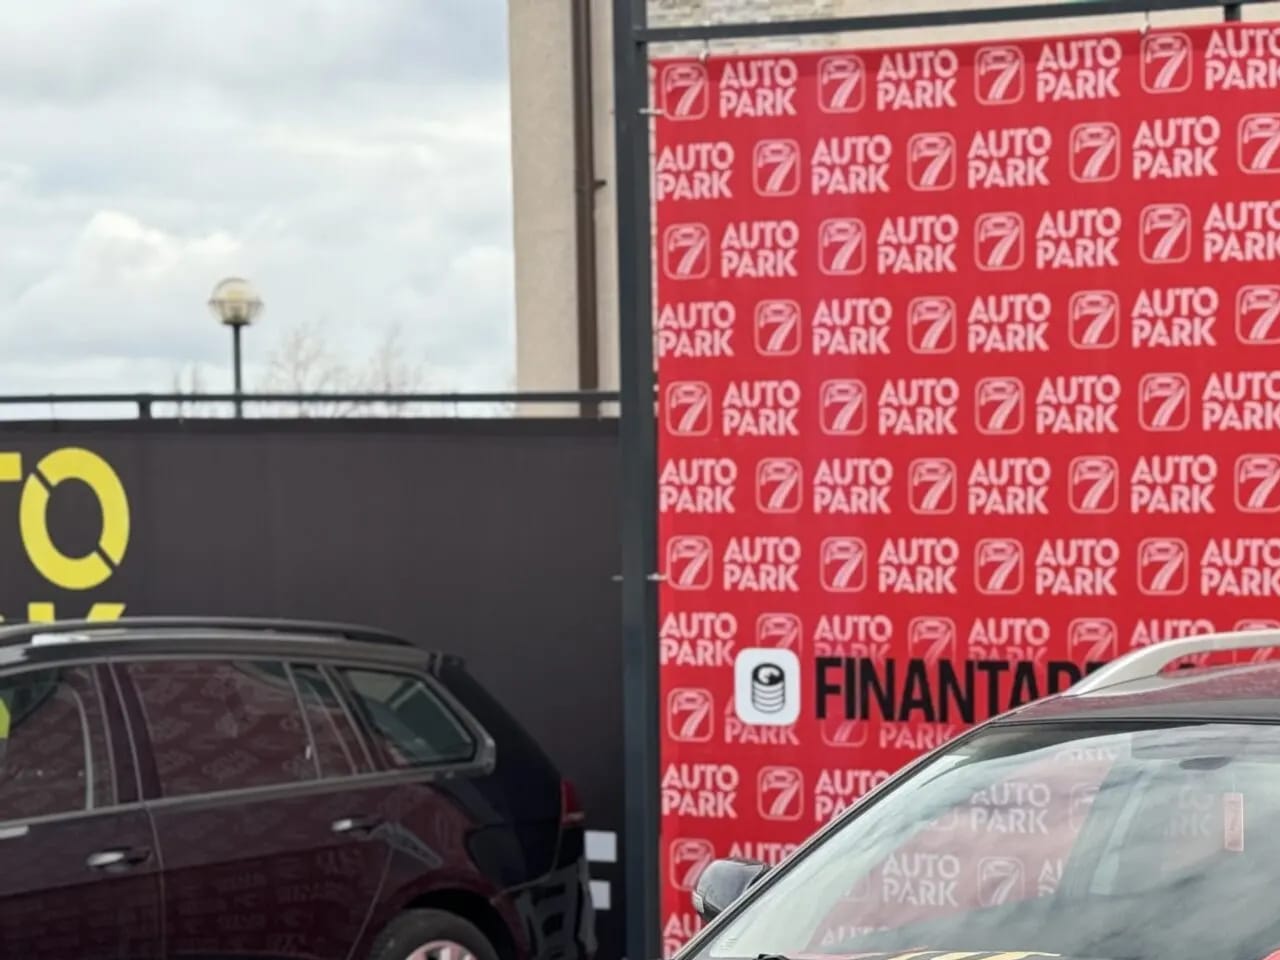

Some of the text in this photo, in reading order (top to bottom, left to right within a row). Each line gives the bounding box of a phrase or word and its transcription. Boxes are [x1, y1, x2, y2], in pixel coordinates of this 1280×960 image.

[876, 49, 957, 81] AUTO
[1036, 37, 1121, 71] AUTO
[720, 58, 797, 88] AUTO
[1037, 67, 1119, 102] PARK
[720, 87, 796, 117] PARK
[877, 79, 956, 110] PARK
[968, 127, 1051, 160] AUTO
[1133, 116, 1220, 150] AUTO
[658, 142, 733, 172] AUTO
[811, 135, 891, 166] AUTO
[1133, 146, 1217, 179] PARK
[656, 170, 732, 200] PARK
[812, 164, 889, 194] PARK
[968, 156, 1049, 188] PARK
[721, 220, 799, 250] AUTO
[878, 214, 958, 245] AUTO
[1036, 208, 1121, 239] AUTO
[722, 248, 797, 277] PARK
[878, 243, 956, 274] PARK
[1037, 237, 1118, 268] PARK
[658, 301, 735, 330] AUTO
[812, 298, 892, 327] AUTO
[968, 293, 1051, 324] AUTO
[1132, 287, 1218, 319] AUTO
[658, 329, 733, 358] PARK
[813, 326, 889, 355] PARK
[968, 322, 1048, 352] PARK
[1132, 317, 1215, 347] PARK
[723, 380, 800, 408] AUTO
[878, 378, 959, 408] AUTO
[1036, 375, 1120, 405] AUTO
[723, 407, 798, 435] PARK
[879, 406, 957, 435] PARK
[1037, 404, 1118, 433] PARK
[659, 458, 737, 486] AUTO
[814, 458, 892, 486] AUTO
[968, 458, 1050, 486] AUTO
[1131, 455, 1217, 484] AUTO
[660, 485, 734, 512] PARK
[814, 485, 890, 513] PARK
[969, 485, 1048, 514] PARK
[1131, 484, 1214, 513] PARK
[724, 537, 800, 563] AUTO
[879, 538, 959, 565] AUTO
[1036, 538, 1119, 567] AUTO
[724, 563, 798, 591] PARK
[879, 565, 956, 593] PARK
[1036, 567, 1116, 595] PARK
[660, 613, 737, 639] AUTO
[814, 615, 893, 640] AUTO
[968, 618, 1050, 645] AUTO
[660, 638, 734, 667] PARK
[661, 764, 738, 791] AUTO
[662, 789, 736, 818] PARK
[973, 782, 1051, 808] AUTO
[970, 806, 1049, 834] PARK
[882, 853, 960, 879] AUTO
[883, 878, 958, 907] PARK
